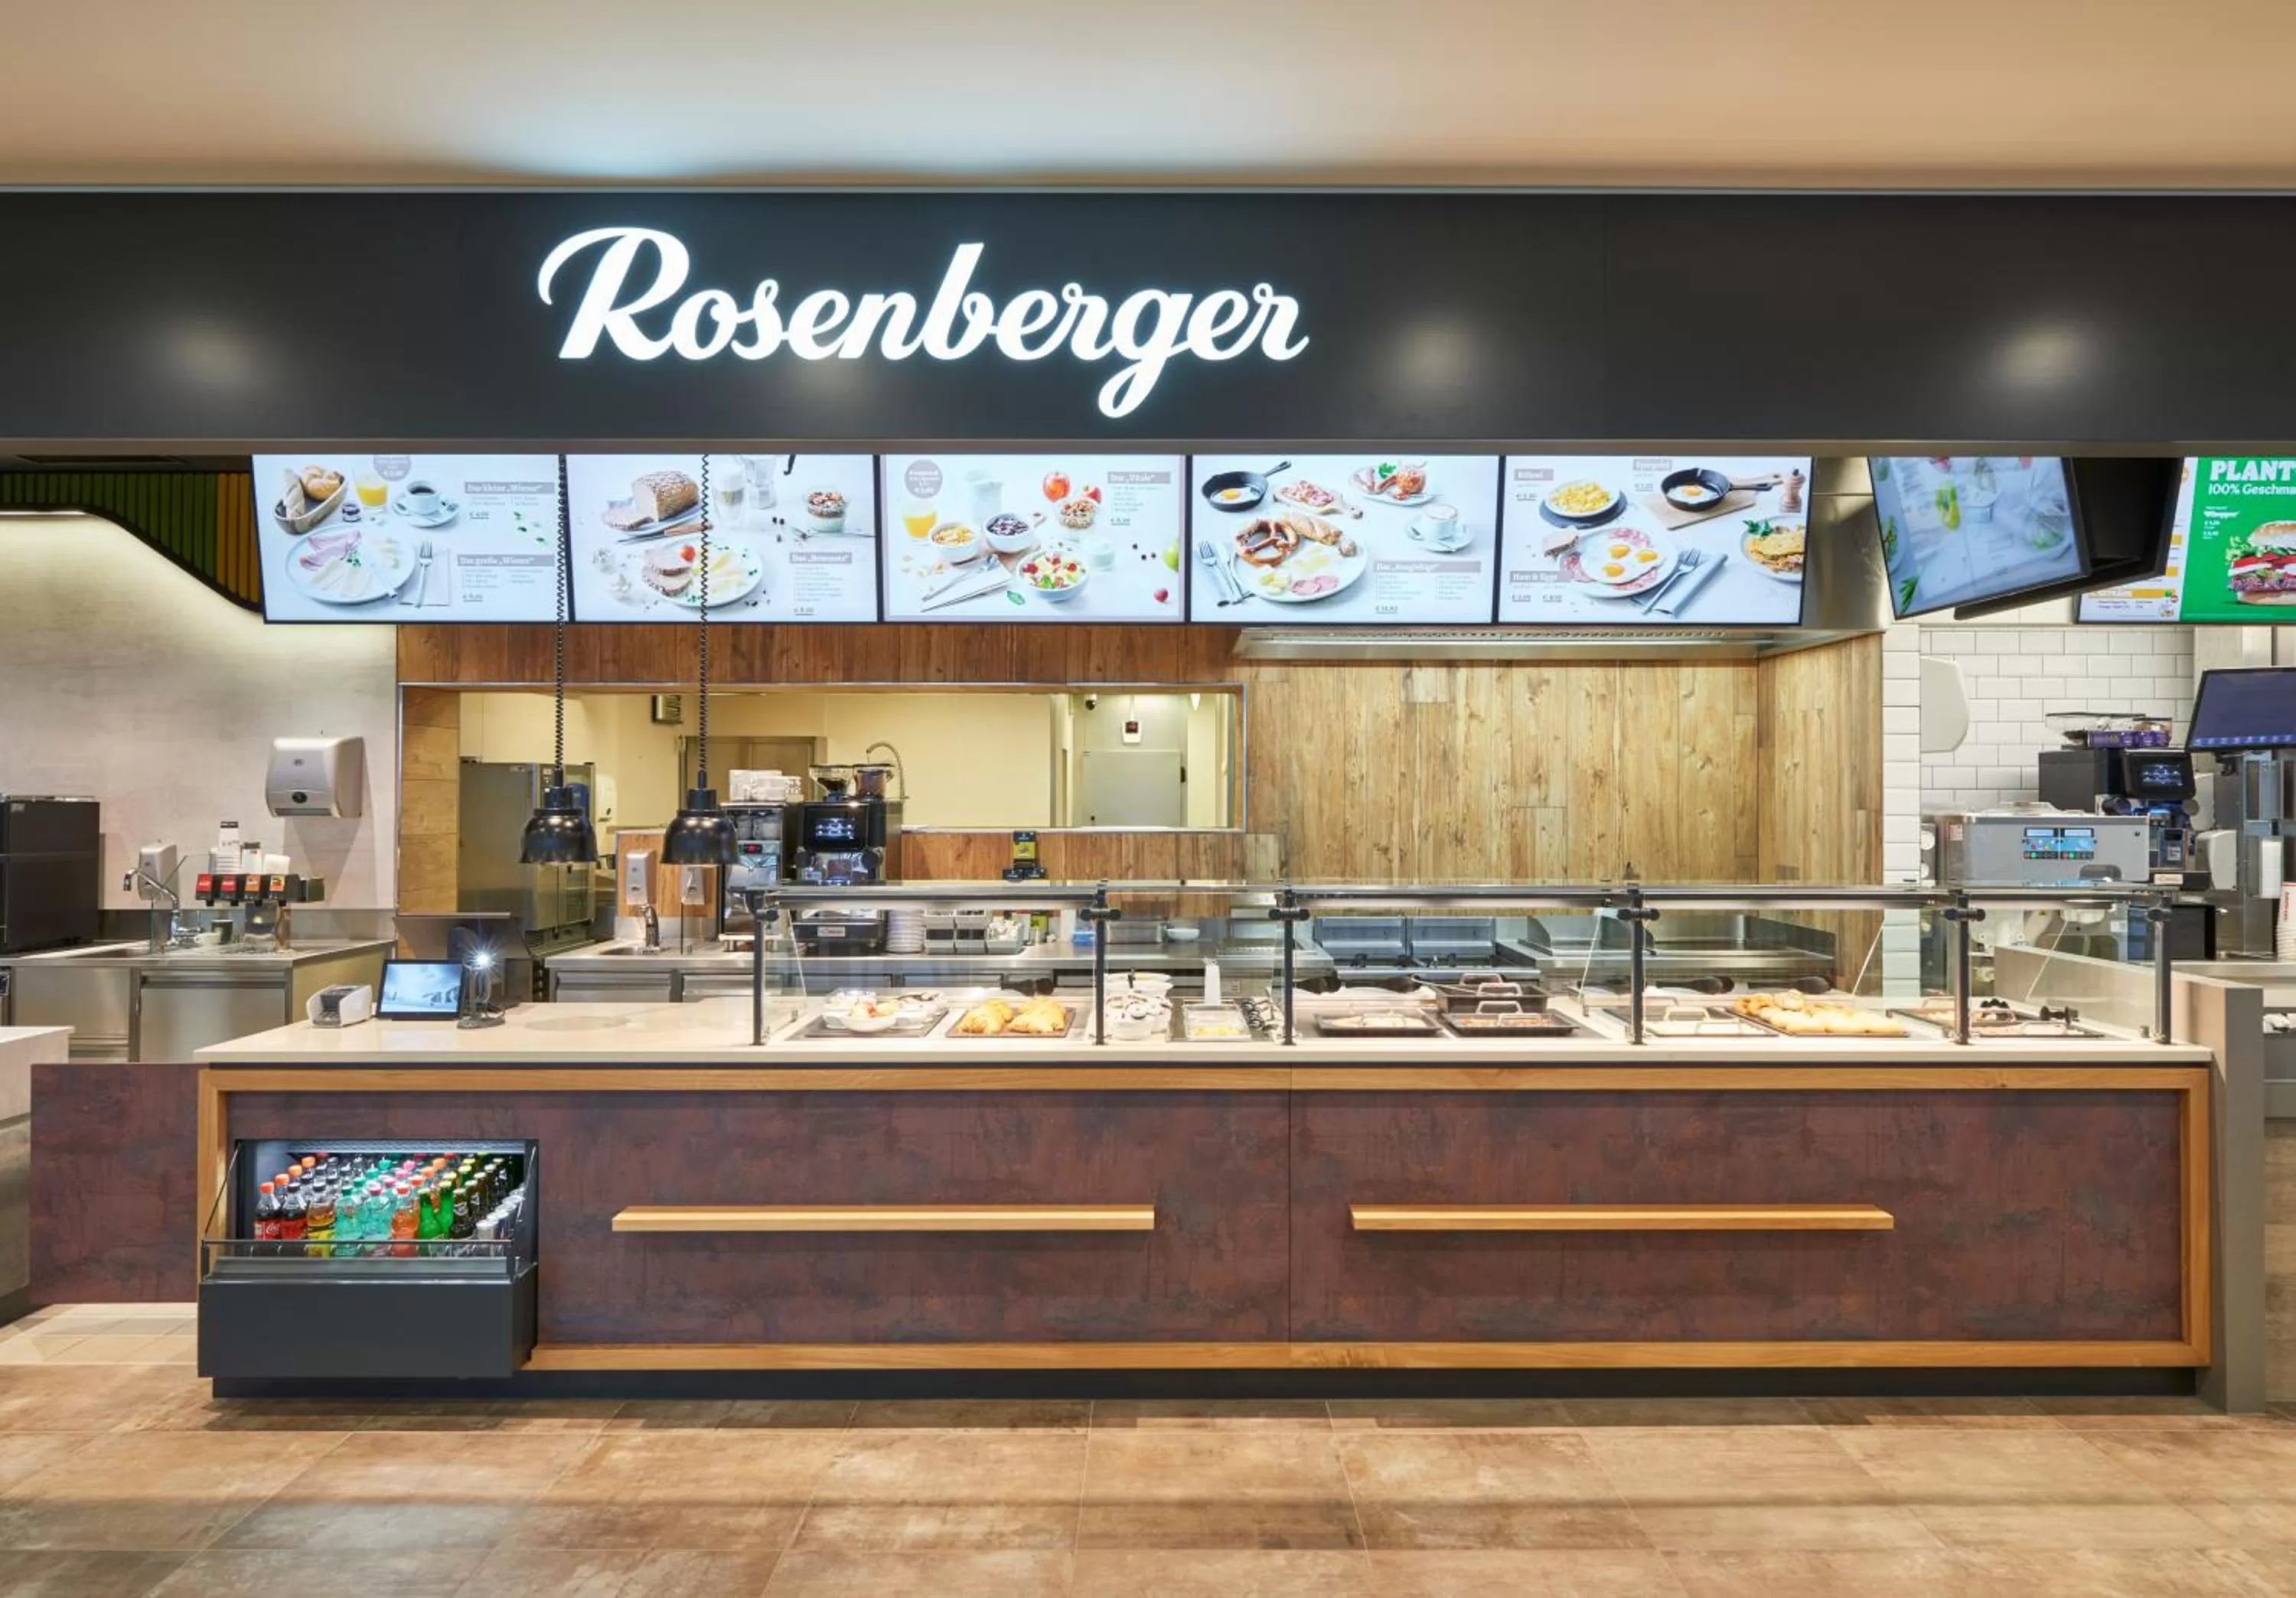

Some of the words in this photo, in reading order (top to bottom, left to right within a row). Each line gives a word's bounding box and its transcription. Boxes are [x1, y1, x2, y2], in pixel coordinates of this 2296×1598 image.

[538, 227, 1309, 419] Rosenberger
[2210, 460, 2296, 481] PLANT
[2208, 483, 2240, 495] 100%
